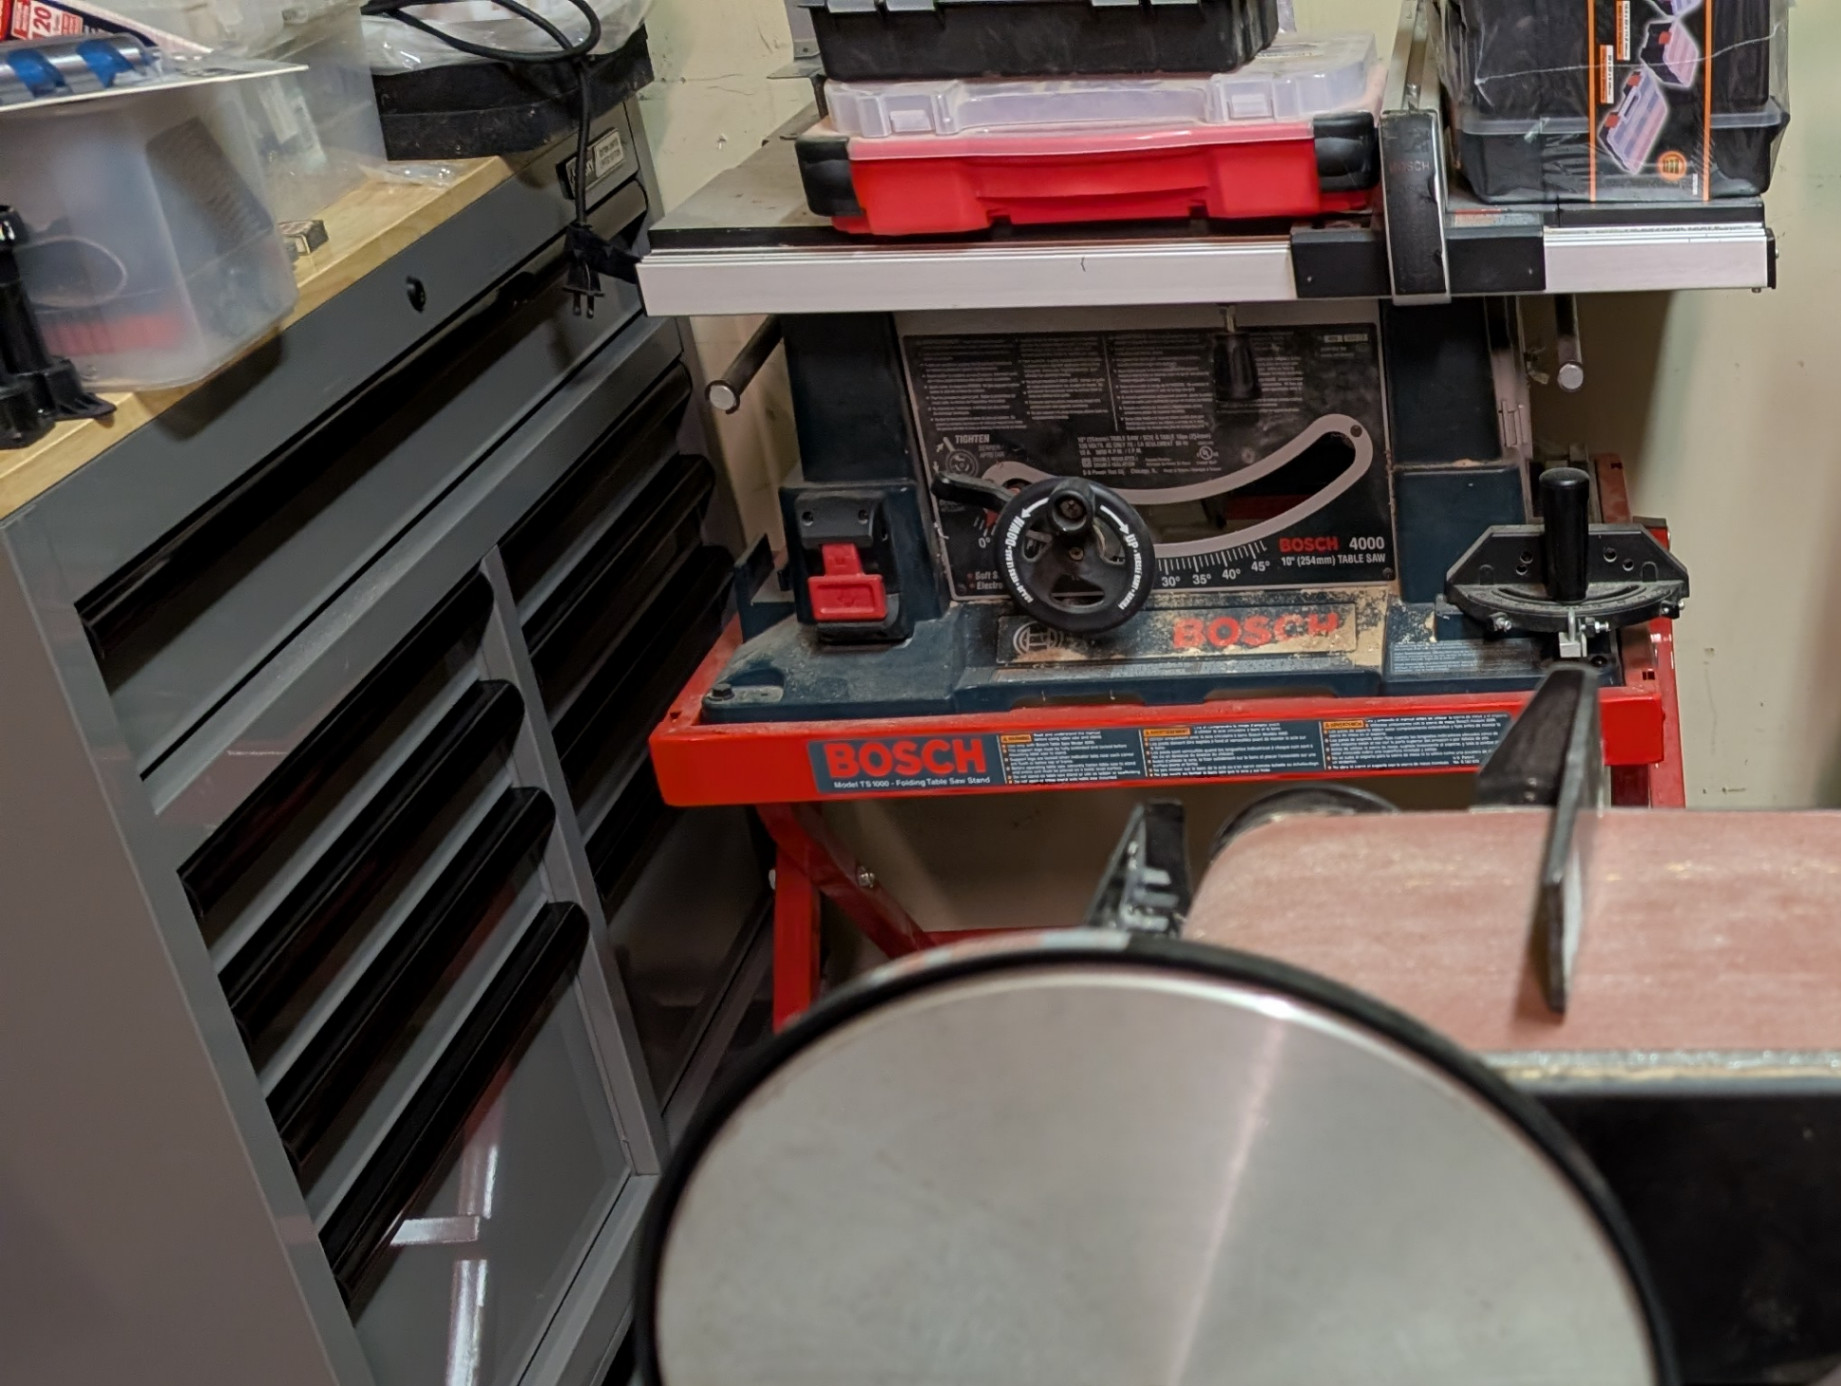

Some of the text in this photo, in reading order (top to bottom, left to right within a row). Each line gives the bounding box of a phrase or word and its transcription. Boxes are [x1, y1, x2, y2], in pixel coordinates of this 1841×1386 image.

[955, 434, 990, 444] TIGHTEN
[1005, 516, 1025, 547] DOWN
[1125, 533, 1139, 548] UP
[1279, 536, 1385, 552] BOSCH 4000
[1251, 560, 1270, 573] 45°
[1297, 555, 1336, 567] (254mm)
[1338, 554, 1364, 564] TABLE
[1366, 553, 1386, 563] SAW
[1192, 573, 1212, 585] 35°
[1222, 568, 1241, 581] 40°
[1161, 576, 1181, 588] 30°
[1172, 612, 1340, 650] BOSCH
[823, 739, 988, 779] BOSCH
[834, 781, 858, 789] Model
[896, 779, 926, 788] Folding
[926, 778, 947, 786] Table
[949, 777, 966, 785] Saw
[967, 776, 991, 784] Stand
